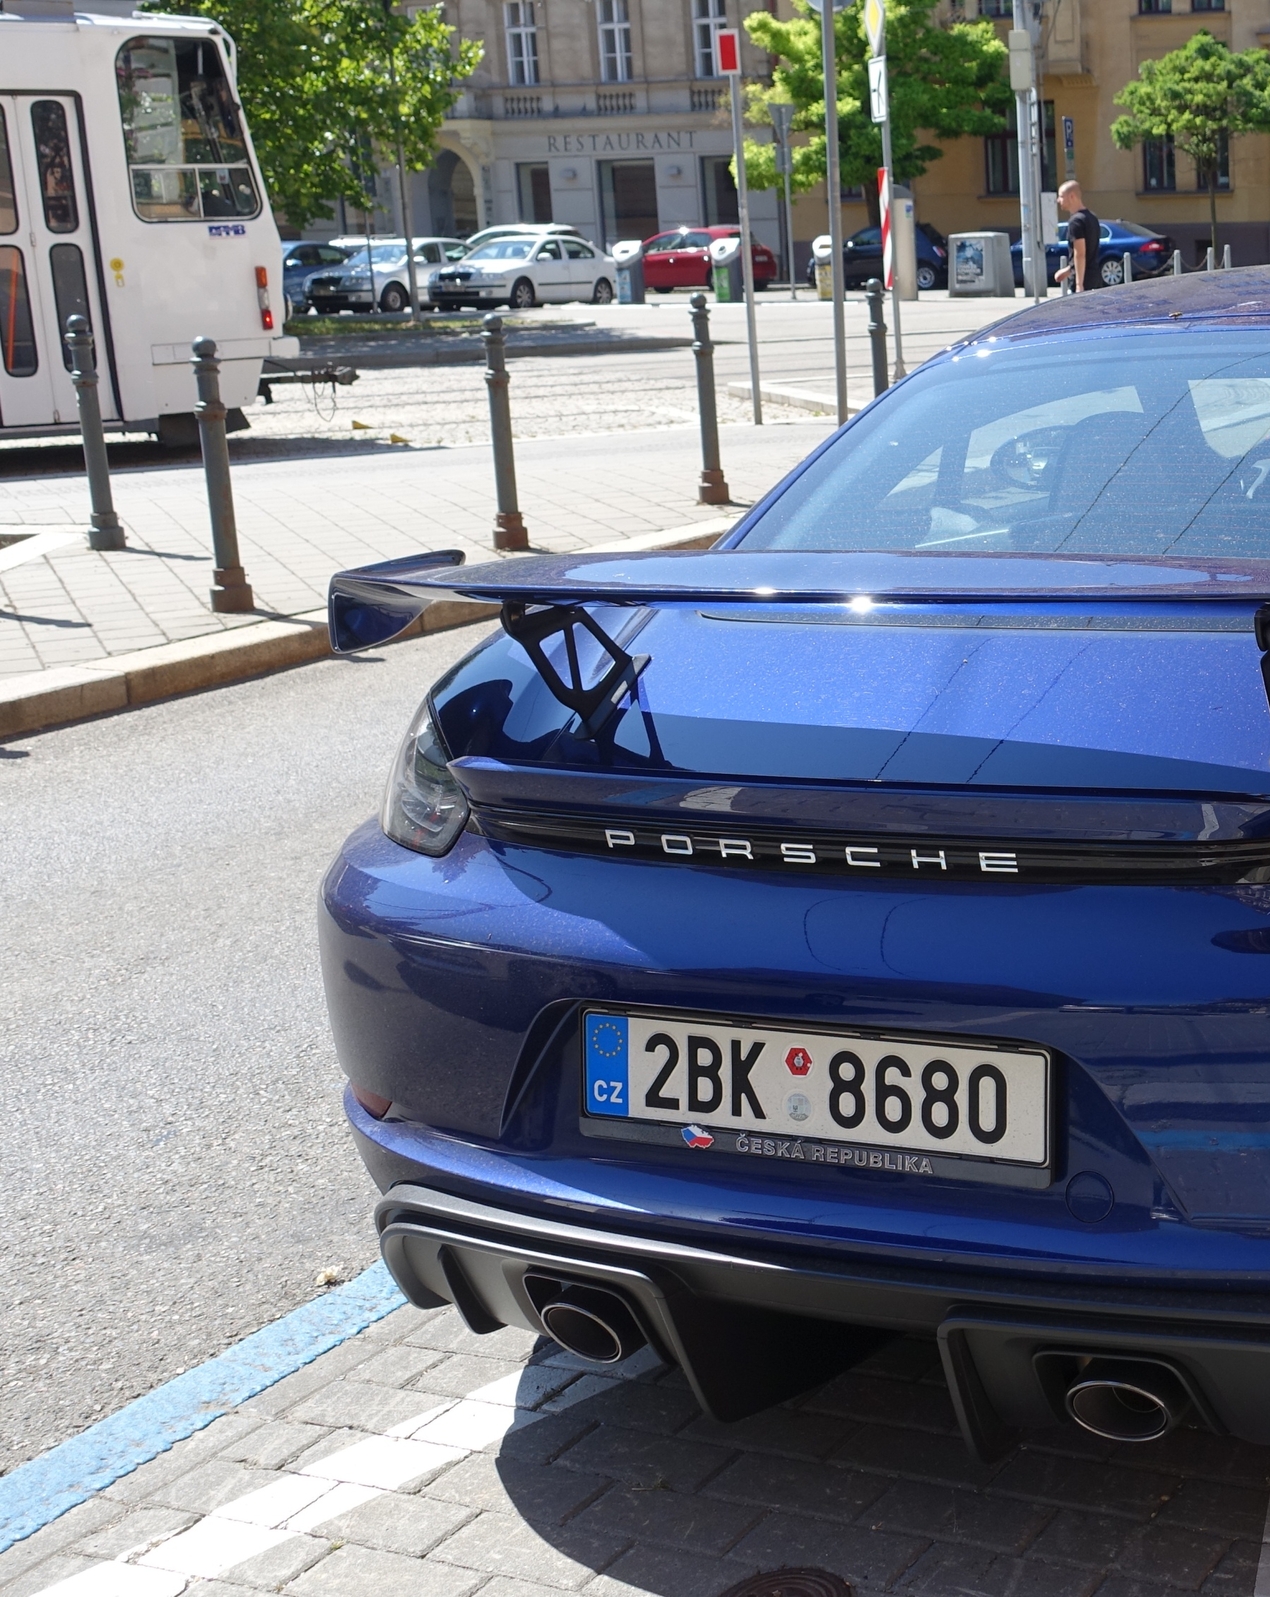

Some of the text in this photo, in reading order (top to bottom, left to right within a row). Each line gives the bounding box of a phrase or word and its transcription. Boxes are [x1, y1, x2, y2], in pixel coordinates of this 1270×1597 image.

[548, 131, 696, 151] RESTAURANT
[1065, 121, 1073, 139] P
[604, 829, 1018, 873] PORSCHE
[594, 1079, 623, 1103] CZ
[644, 1032, 1007, 1144] 2BK 8680
[735, 1133, 934, 1174] ČESKÁ REPUBLIKA
